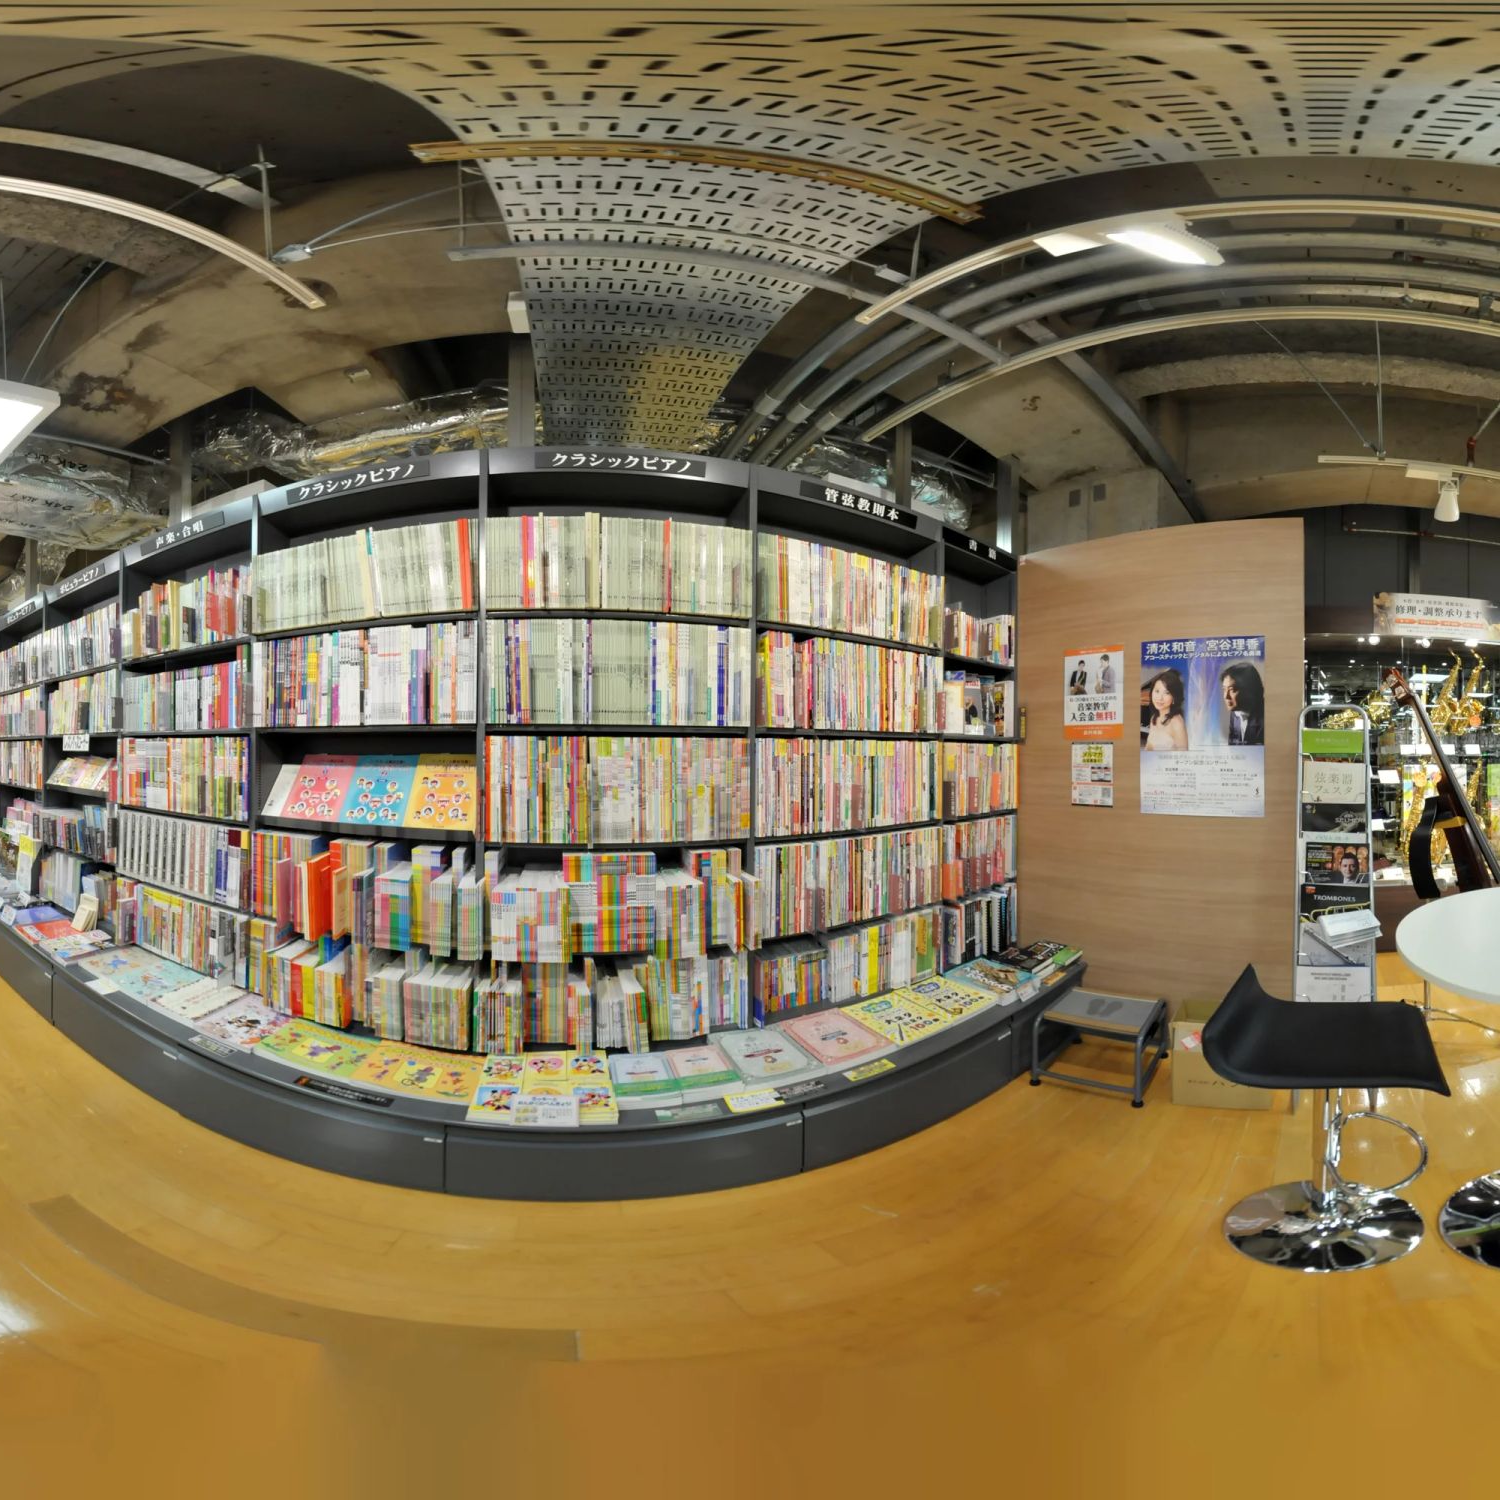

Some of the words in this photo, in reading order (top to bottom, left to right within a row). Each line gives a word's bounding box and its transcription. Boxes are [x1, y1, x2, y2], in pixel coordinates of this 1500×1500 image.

[551, 452, 692, 473] クラシックピアノ
[298, 463, 415, 501] クラシックピアノ
[824, 487, 900, 521] 管弦教則本
[155, 519, 204, 550] 声楽・合唱
[59, 567, 99, 594] ポピュラーピアノ
[1395, 604, 1482, 619] 修理・調整承ります
[1077, 701, 1109, 712] 音楽教室
[1315, 772, 1353, 785] 弦楽器
[1315, 785, 1353, 794] フェスタ
[1313, 893, 1356, 903] TROMBONES
